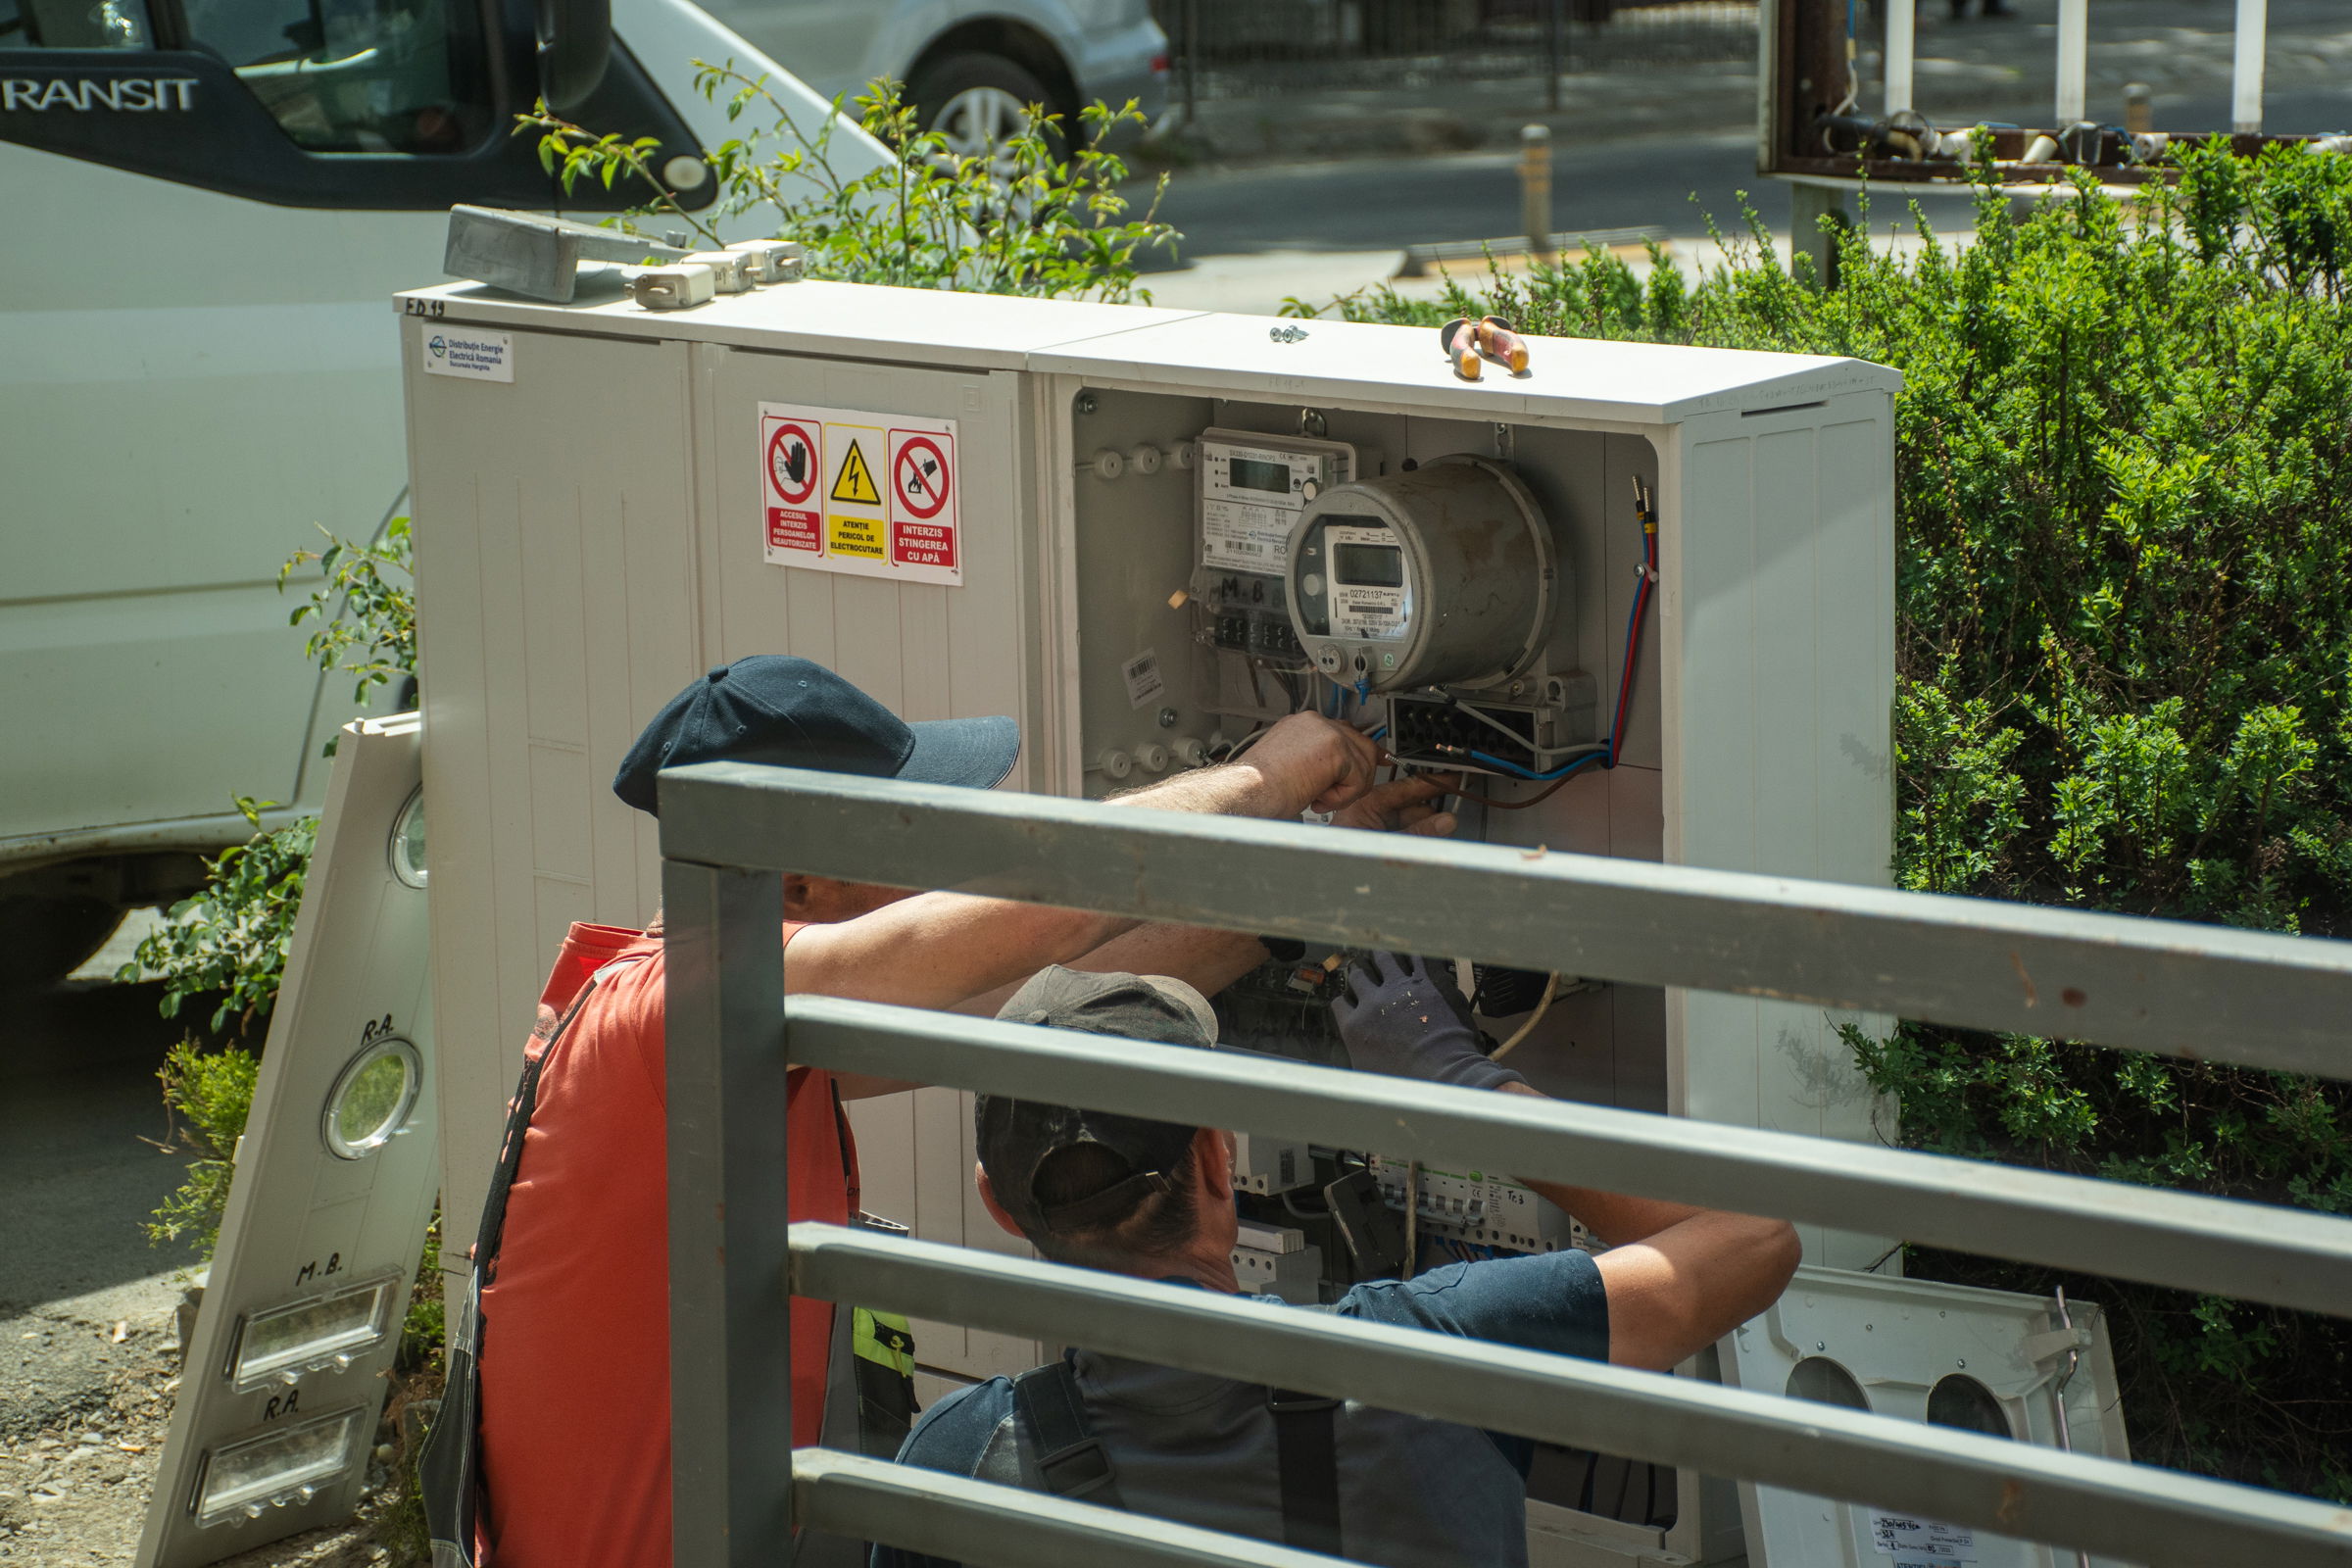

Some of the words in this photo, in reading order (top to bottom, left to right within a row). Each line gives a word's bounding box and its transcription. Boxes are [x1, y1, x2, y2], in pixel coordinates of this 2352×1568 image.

[2, 78, 200, 110] RANSIT
[481, 343, 504, 354] Energie
[475, 354, 502, 364] Romania
[780, 510, 808, 520] ACCESUL
[780, 519, 808, 529] INTERZIS
[773, 527, 816, 540] PERSOANELOR
[838, 531, 864, 541] PERICOL
[903, 524, 944, 538] INTERZIS
[772, 536, 817, 550] NEAUTORIZATE
[830, 541, 884, 555] ELECTROCUTARE
[899, 537, 949, 552] STINGEREA
[907, 551, 919, 561] CU
[1349, 589, 1383, 599] 02721137
